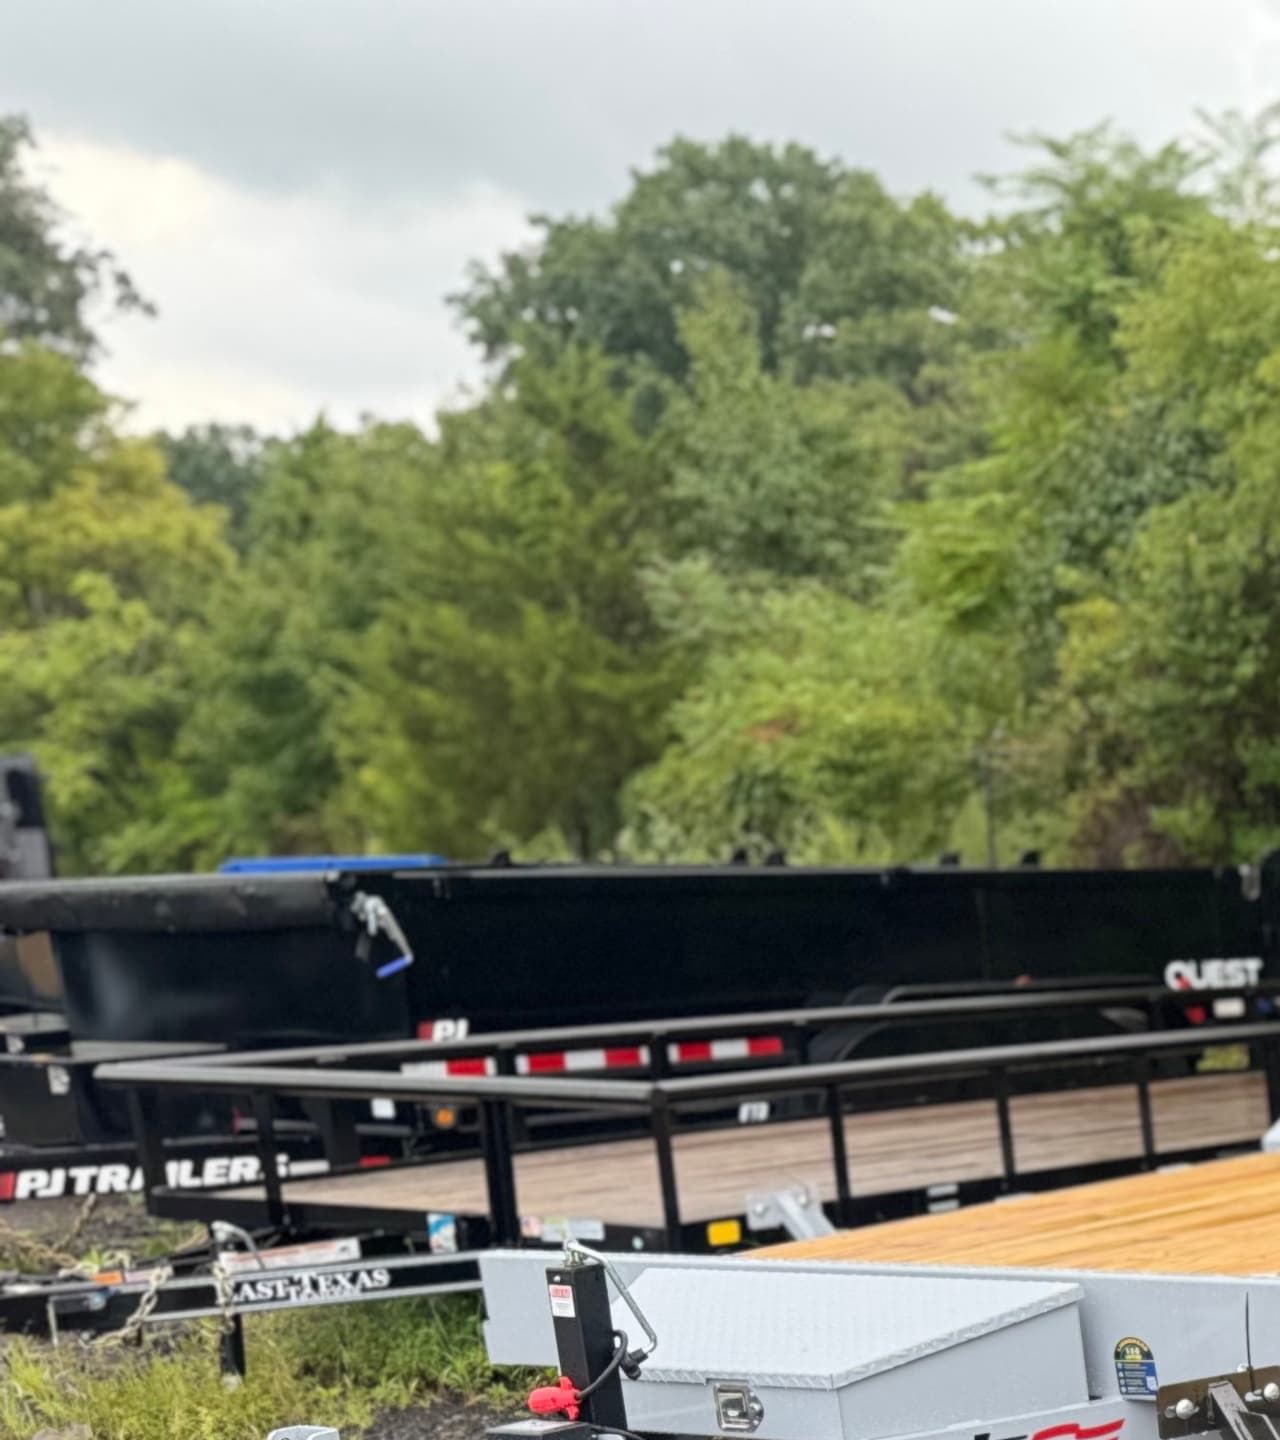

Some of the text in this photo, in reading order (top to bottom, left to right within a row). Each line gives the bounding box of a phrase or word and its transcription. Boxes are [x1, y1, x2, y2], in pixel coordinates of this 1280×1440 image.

[1164, 957, 1263, 990] QUEST
[228, 1280, 290, 1302] AST
[294, 1268, 390, 1294] TEXAS
